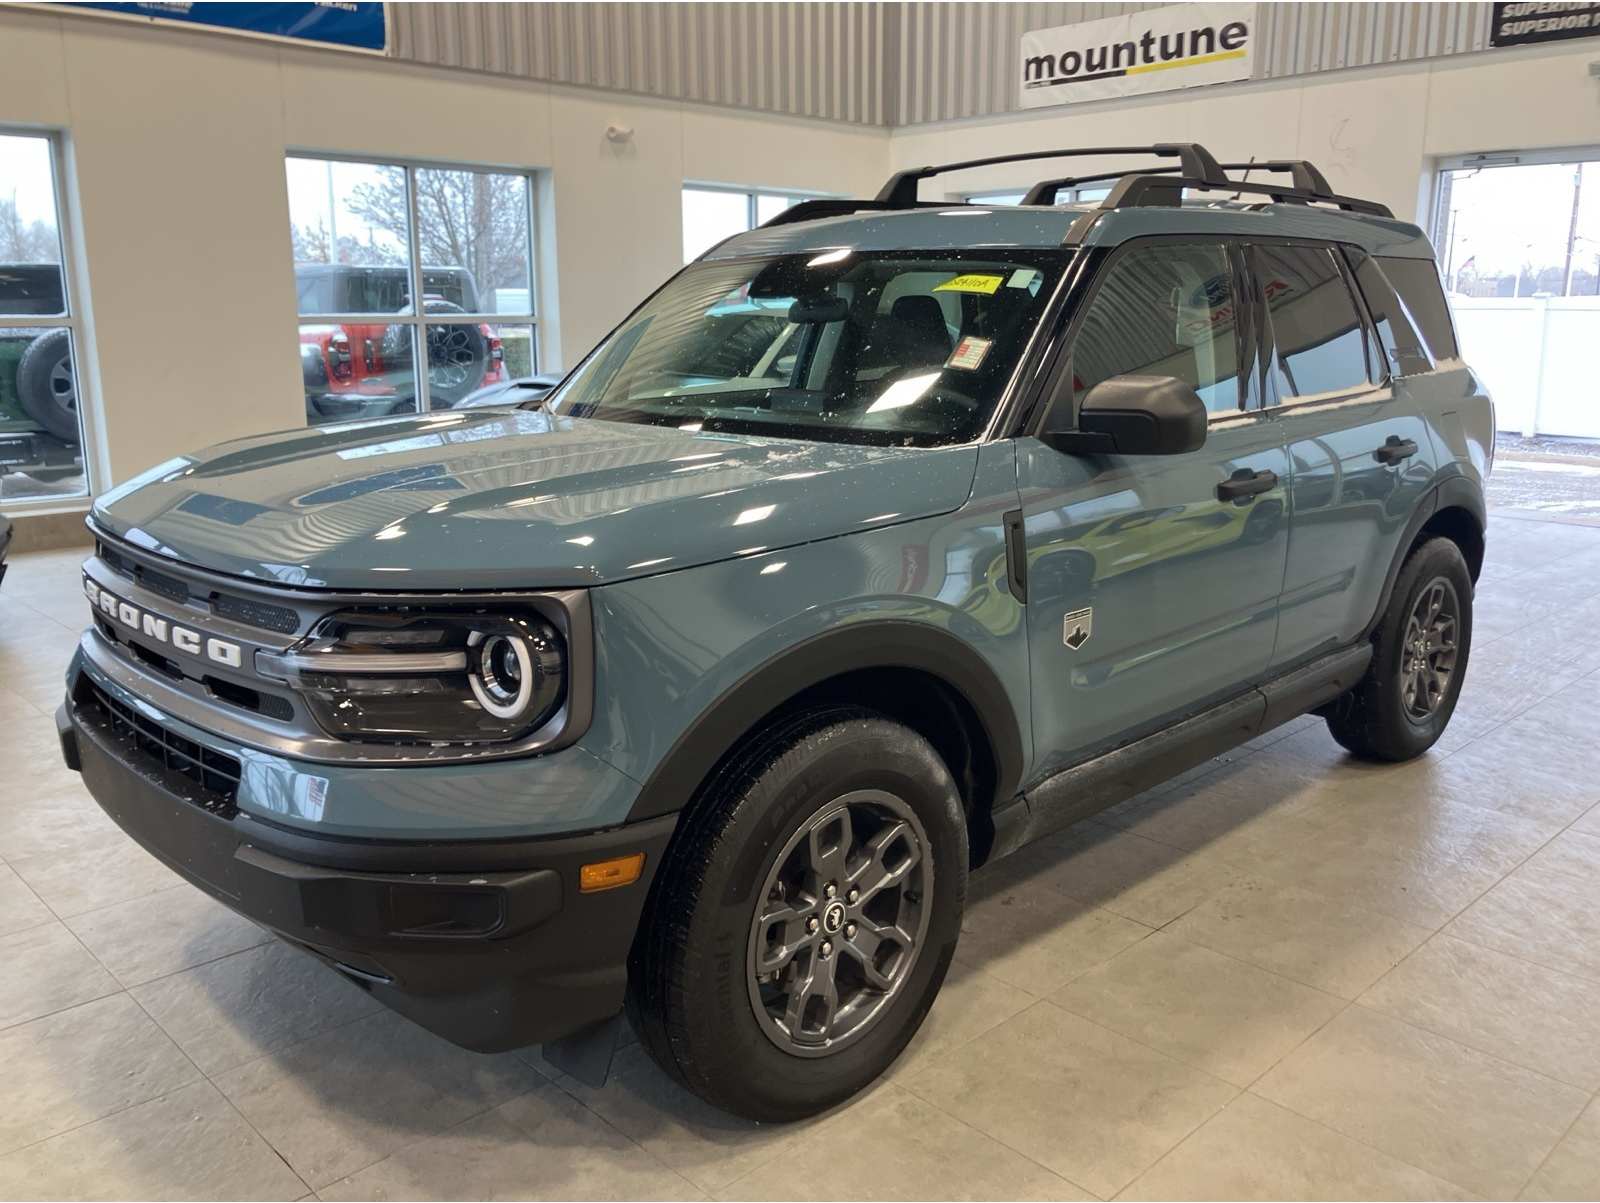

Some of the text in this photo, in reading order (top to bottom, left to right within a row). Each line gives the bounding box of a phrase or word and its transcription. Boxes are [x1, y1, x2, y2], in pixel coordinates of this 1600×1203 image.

[1499, 13, 1591, 36] SUPERIOR
[1501, 2, 1591, 18] SUPERIOR
[1025, 21, 1248, 81] mountune
[85, 579, 242, 668] BRONCO
